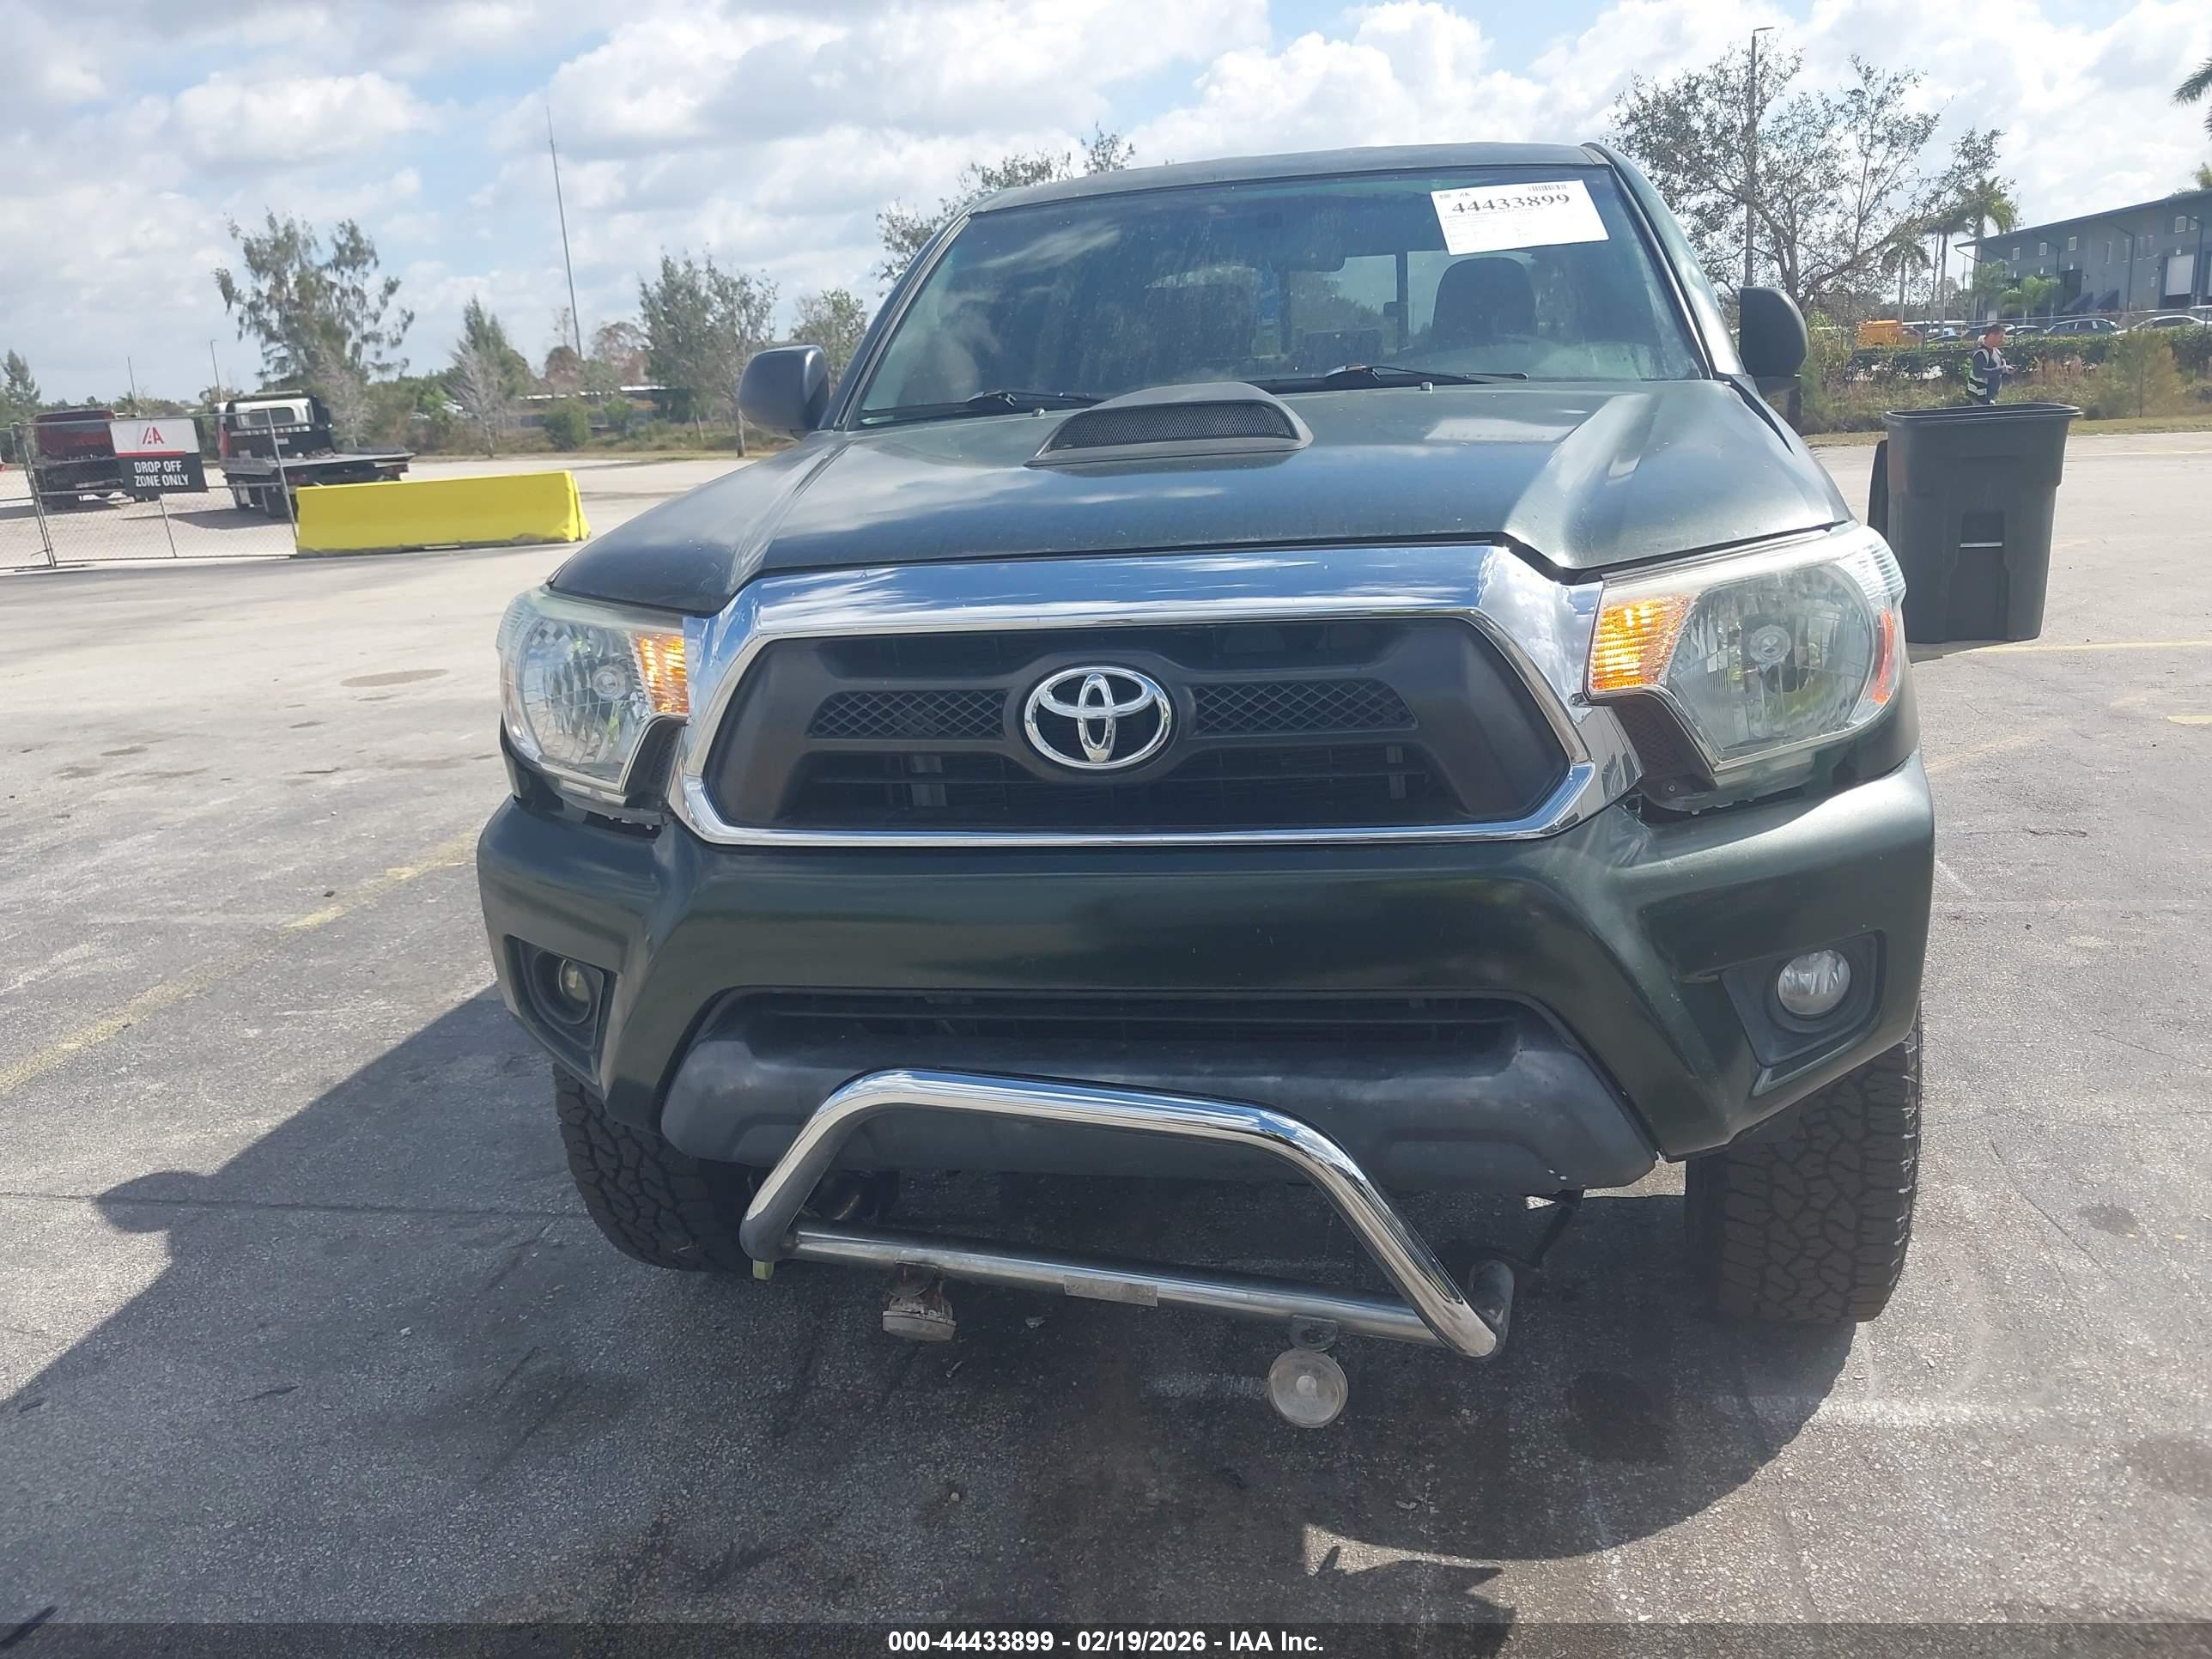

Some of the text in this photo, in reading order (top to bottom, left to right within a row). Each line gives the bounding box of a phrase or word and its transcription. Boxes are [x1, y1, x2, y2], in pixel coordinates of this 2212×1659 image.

[1451, 193, 1571, 214] 44433899
[134, 459, 182, 474] DROP OFF
[134, 473, 189, 488] ZONE ONLY
